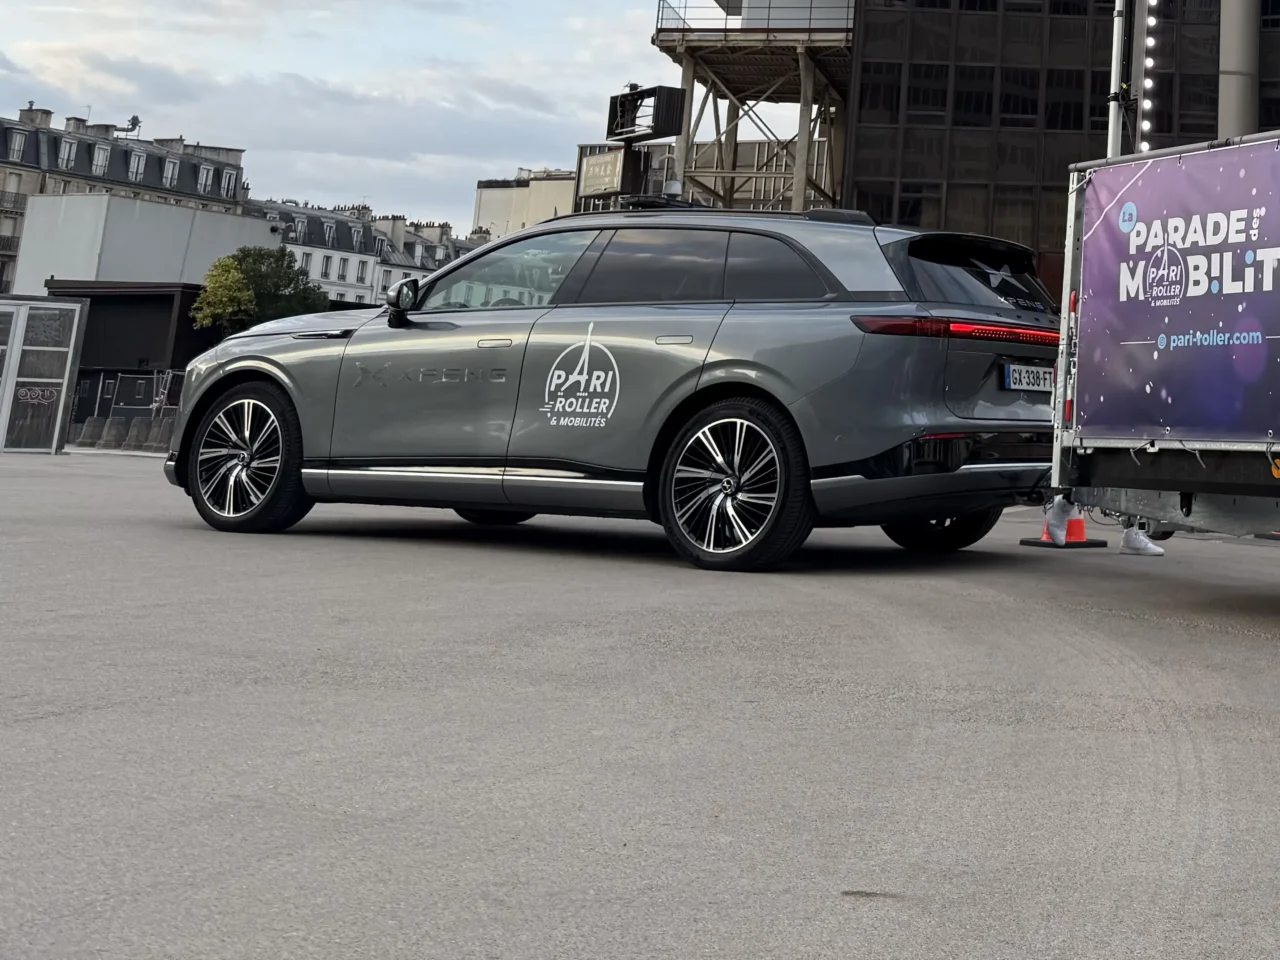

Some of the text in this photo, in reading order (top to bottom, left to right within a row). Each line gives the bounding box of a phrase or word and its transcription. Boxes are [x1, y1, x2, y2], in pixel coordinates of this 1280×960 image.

[1121, 212, 1134, 222] La
[1129, 208, 1249, 255] PARADE
[1152, 284, 1181, 297] ROLLER
[1170, 329, 1262, 350] pari-roller.com
[1011, 368, 1053, 388] GX-338-FT
[554, 397, 610, 413] ROLLER
[550, 415, 607, 427] & MOBILITÉS
